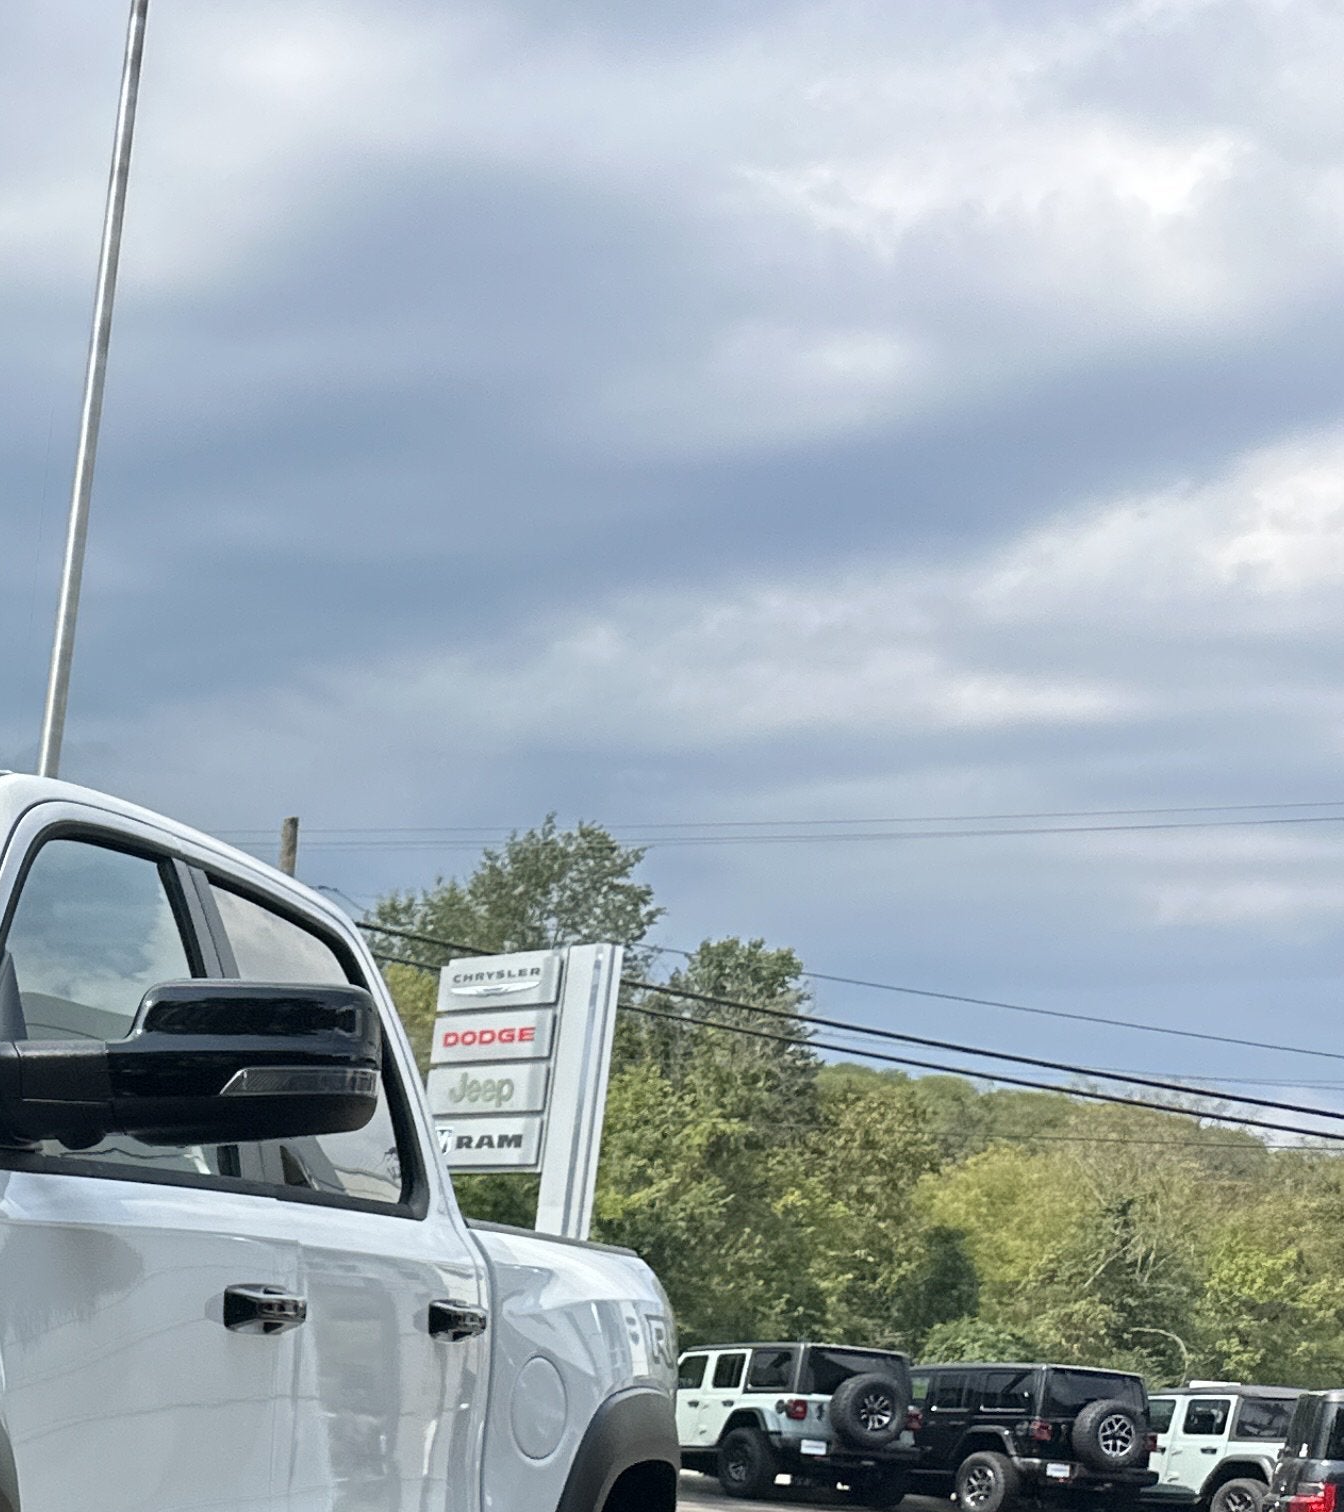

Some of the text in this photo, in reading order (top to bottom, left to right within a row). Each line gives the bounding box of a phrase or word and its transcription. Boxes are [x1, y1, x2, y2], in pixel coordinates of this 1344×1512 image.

[453, 967, 541, 984] CHRYSLER
[443, 1027, 536, 1048] DODGE
[449, 1072, 515, 1108] Jeep
[455, 1134, 523, 1150] RAM
